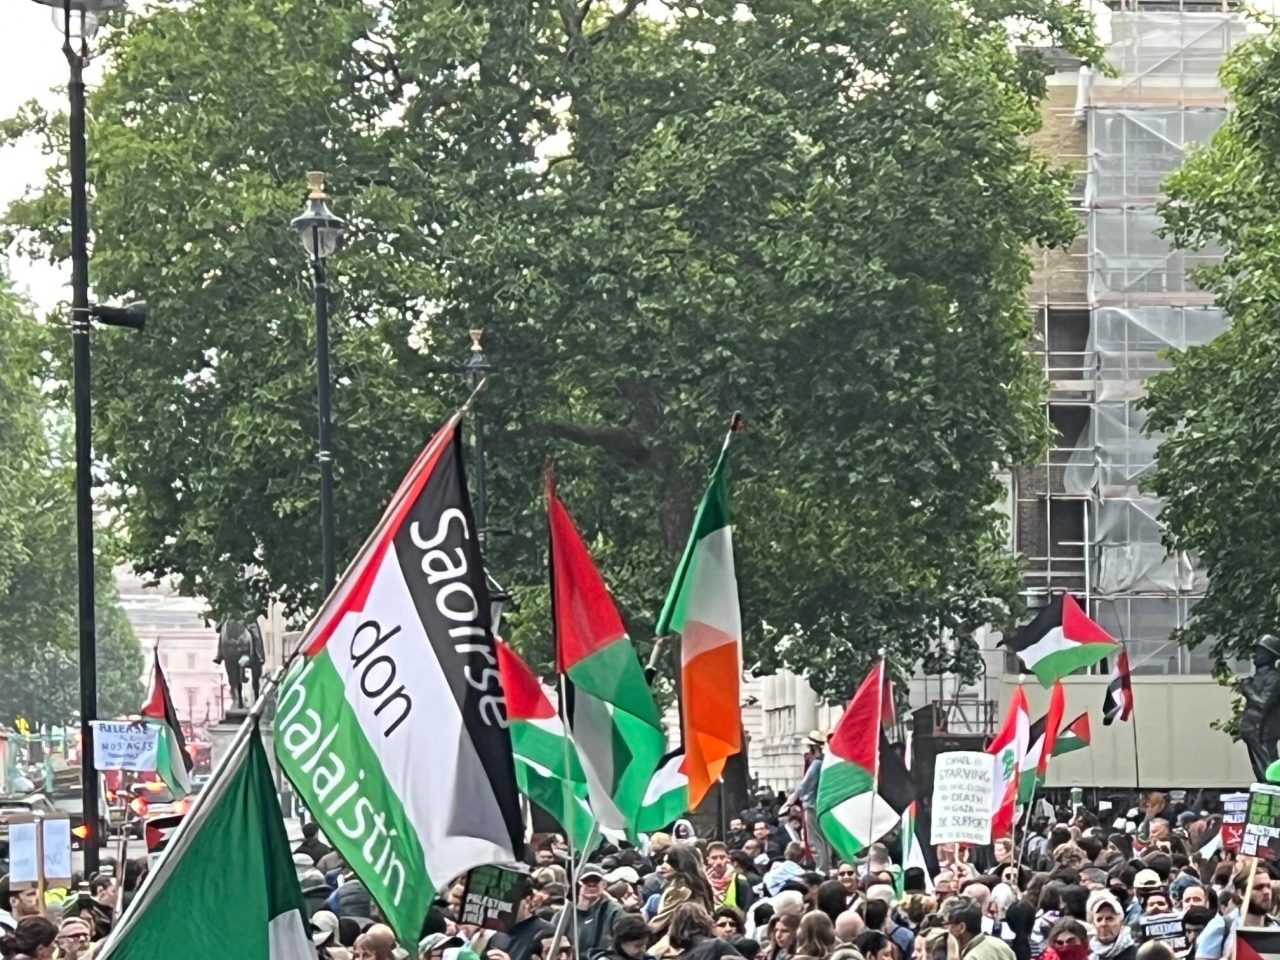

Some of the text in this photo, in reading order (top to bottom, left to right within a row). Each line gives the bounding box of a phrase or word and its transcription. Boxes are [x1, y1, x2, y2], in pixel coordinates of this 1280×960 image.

[410, 508, 509, 729] Saoirse
[350, 620, 412, 738] don
[938, 768, 991, 783] STARVING
